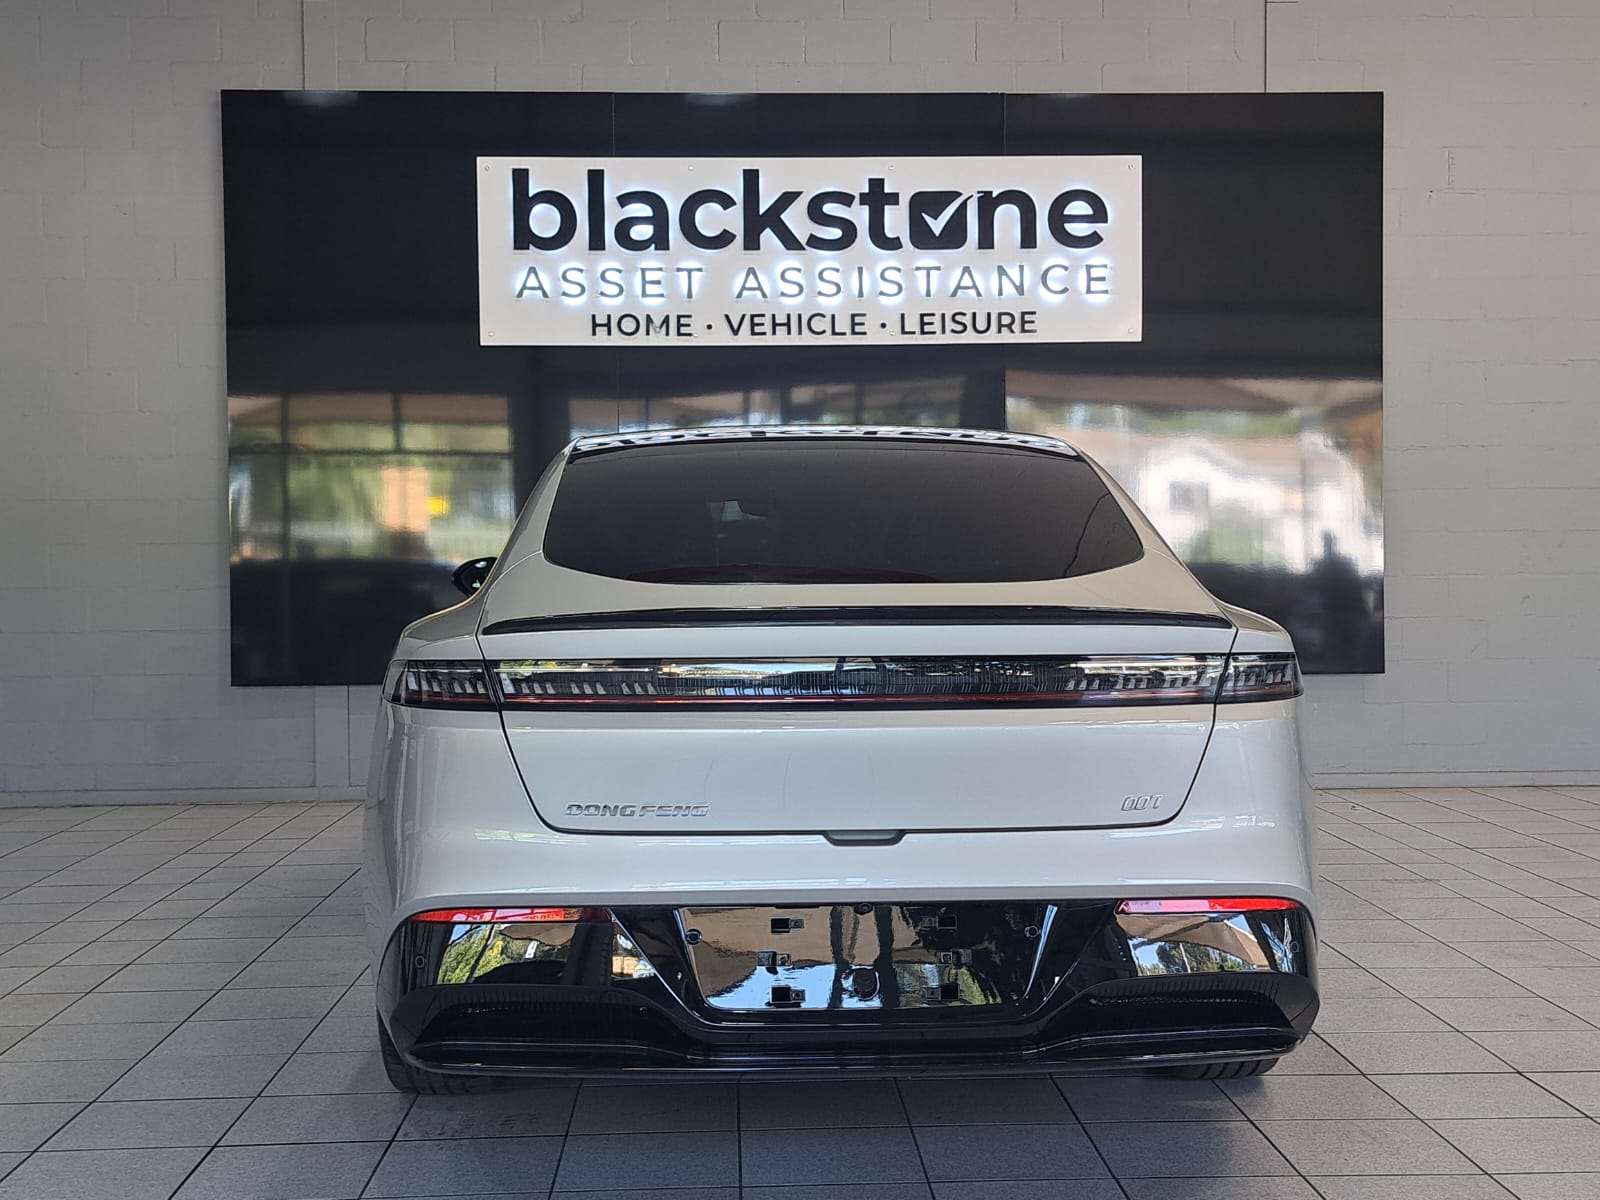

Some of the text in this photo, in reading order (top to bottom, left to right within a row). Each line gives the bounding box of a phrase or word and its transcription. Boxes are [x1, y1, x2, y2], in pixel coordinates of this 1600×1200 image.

[511, 168, 1109, 251] blackstone
[515, 264, 1111, 299] ASSET ASSISTANCE
[591, 310, 1038, 337] HOME VEHICLE LEISURE
